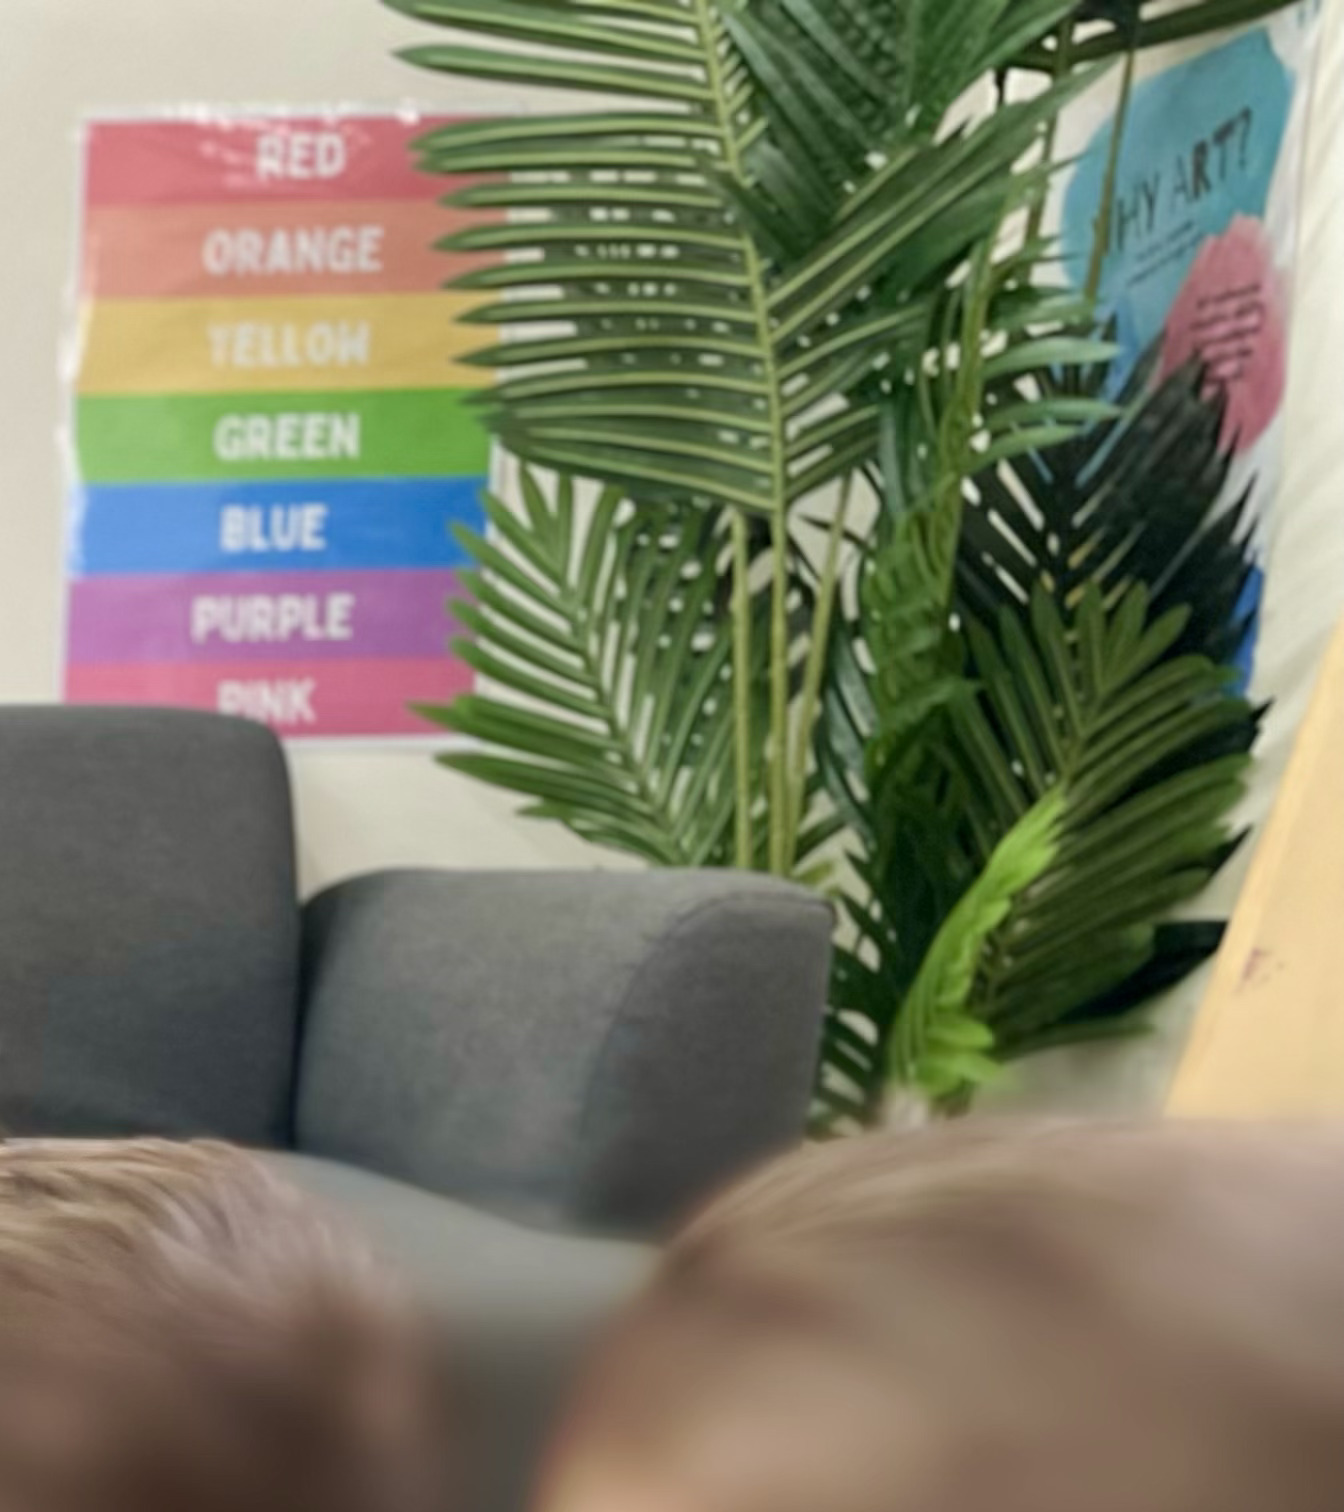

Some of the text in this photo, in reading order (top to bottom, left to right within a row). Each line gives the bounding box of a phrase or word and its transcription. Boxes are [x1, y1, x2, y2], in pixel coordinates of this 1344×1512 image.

[255, 131, 346, 180] RED
[1168, 105, 1253, 214] ART?
[202, 224, 386, 275] ORANGE
[207, 318, 372, 368] YELLOW
[213, 412, 362, 462] GREEN
[220, 502, 328, 552] BLUE
[191, 592, 355, 645] PURPLE
[217, 676, 316, 725] PINK
